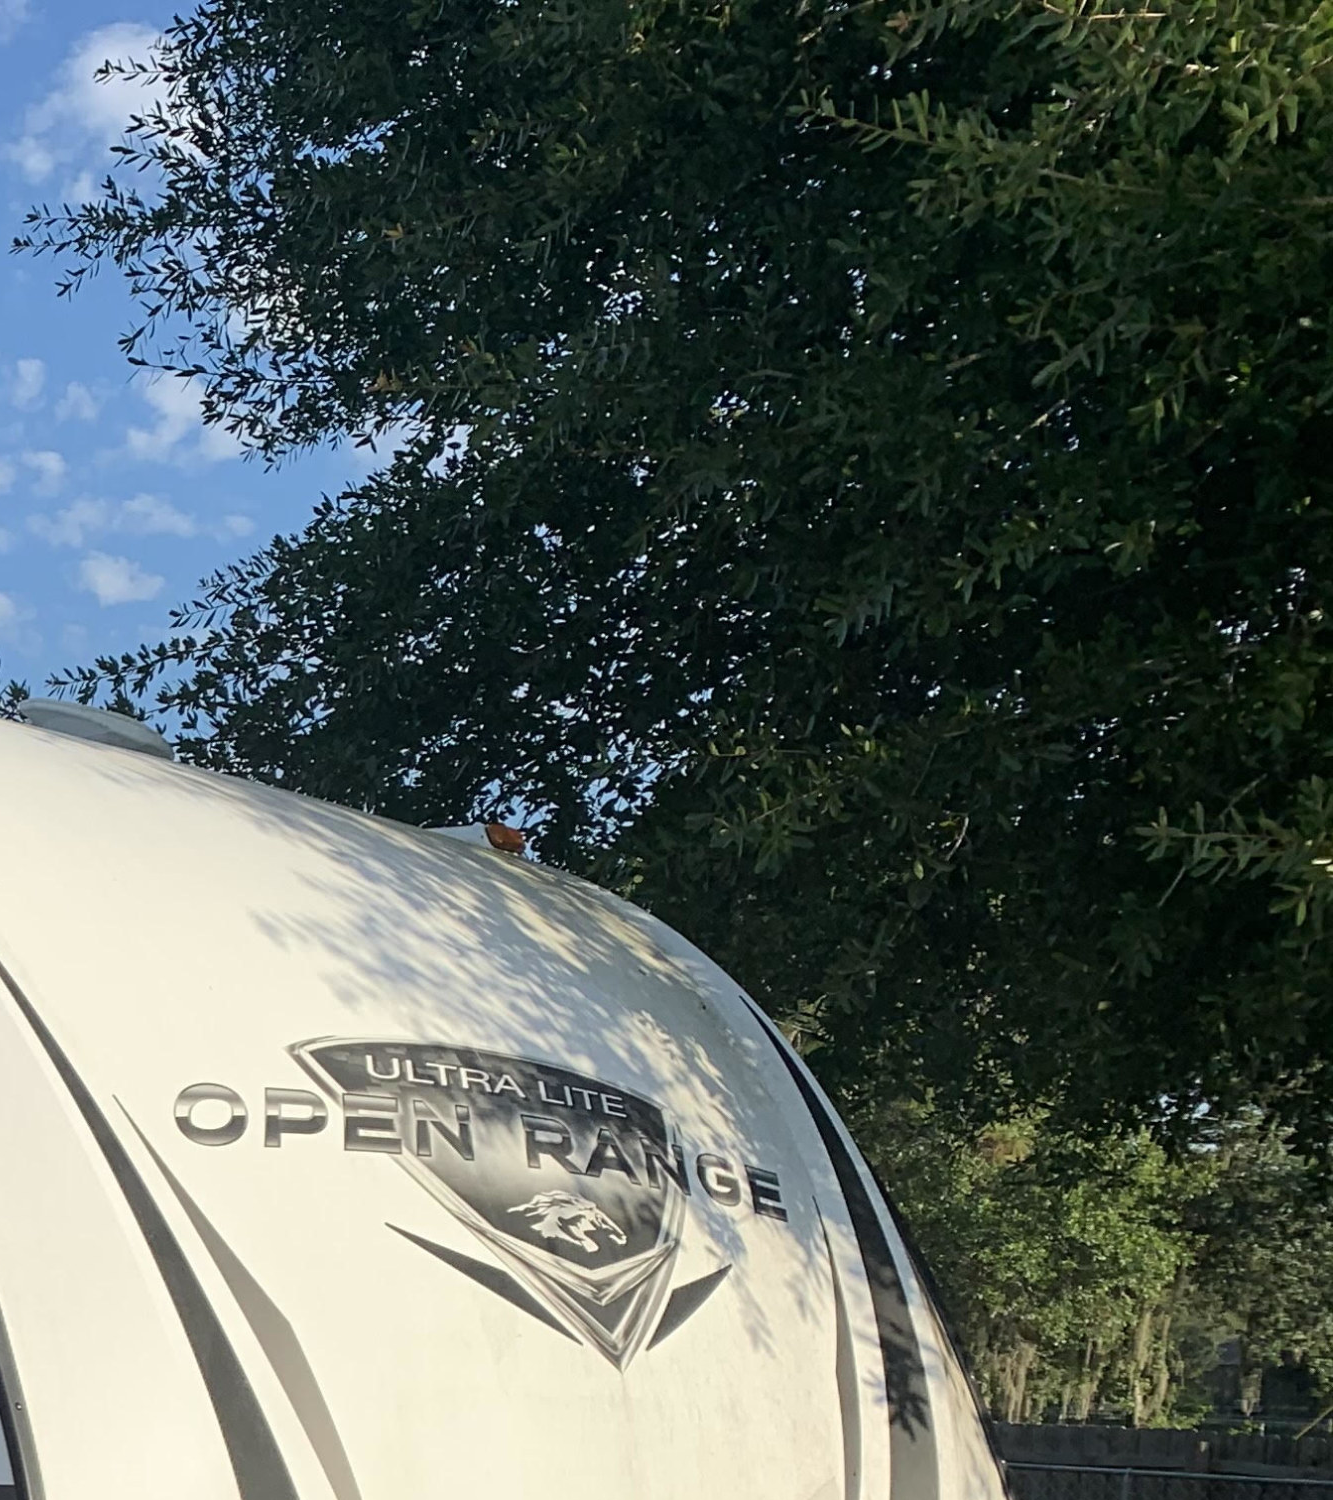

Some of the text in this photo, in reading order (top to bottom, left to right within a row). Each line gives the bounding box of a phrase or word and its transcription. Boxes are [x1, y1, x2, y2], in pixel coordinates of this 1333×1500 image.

[365, 1054, 628, 1118] ULTRA LITE
[173, 1082, 788, 1222] OPEN RANGE
